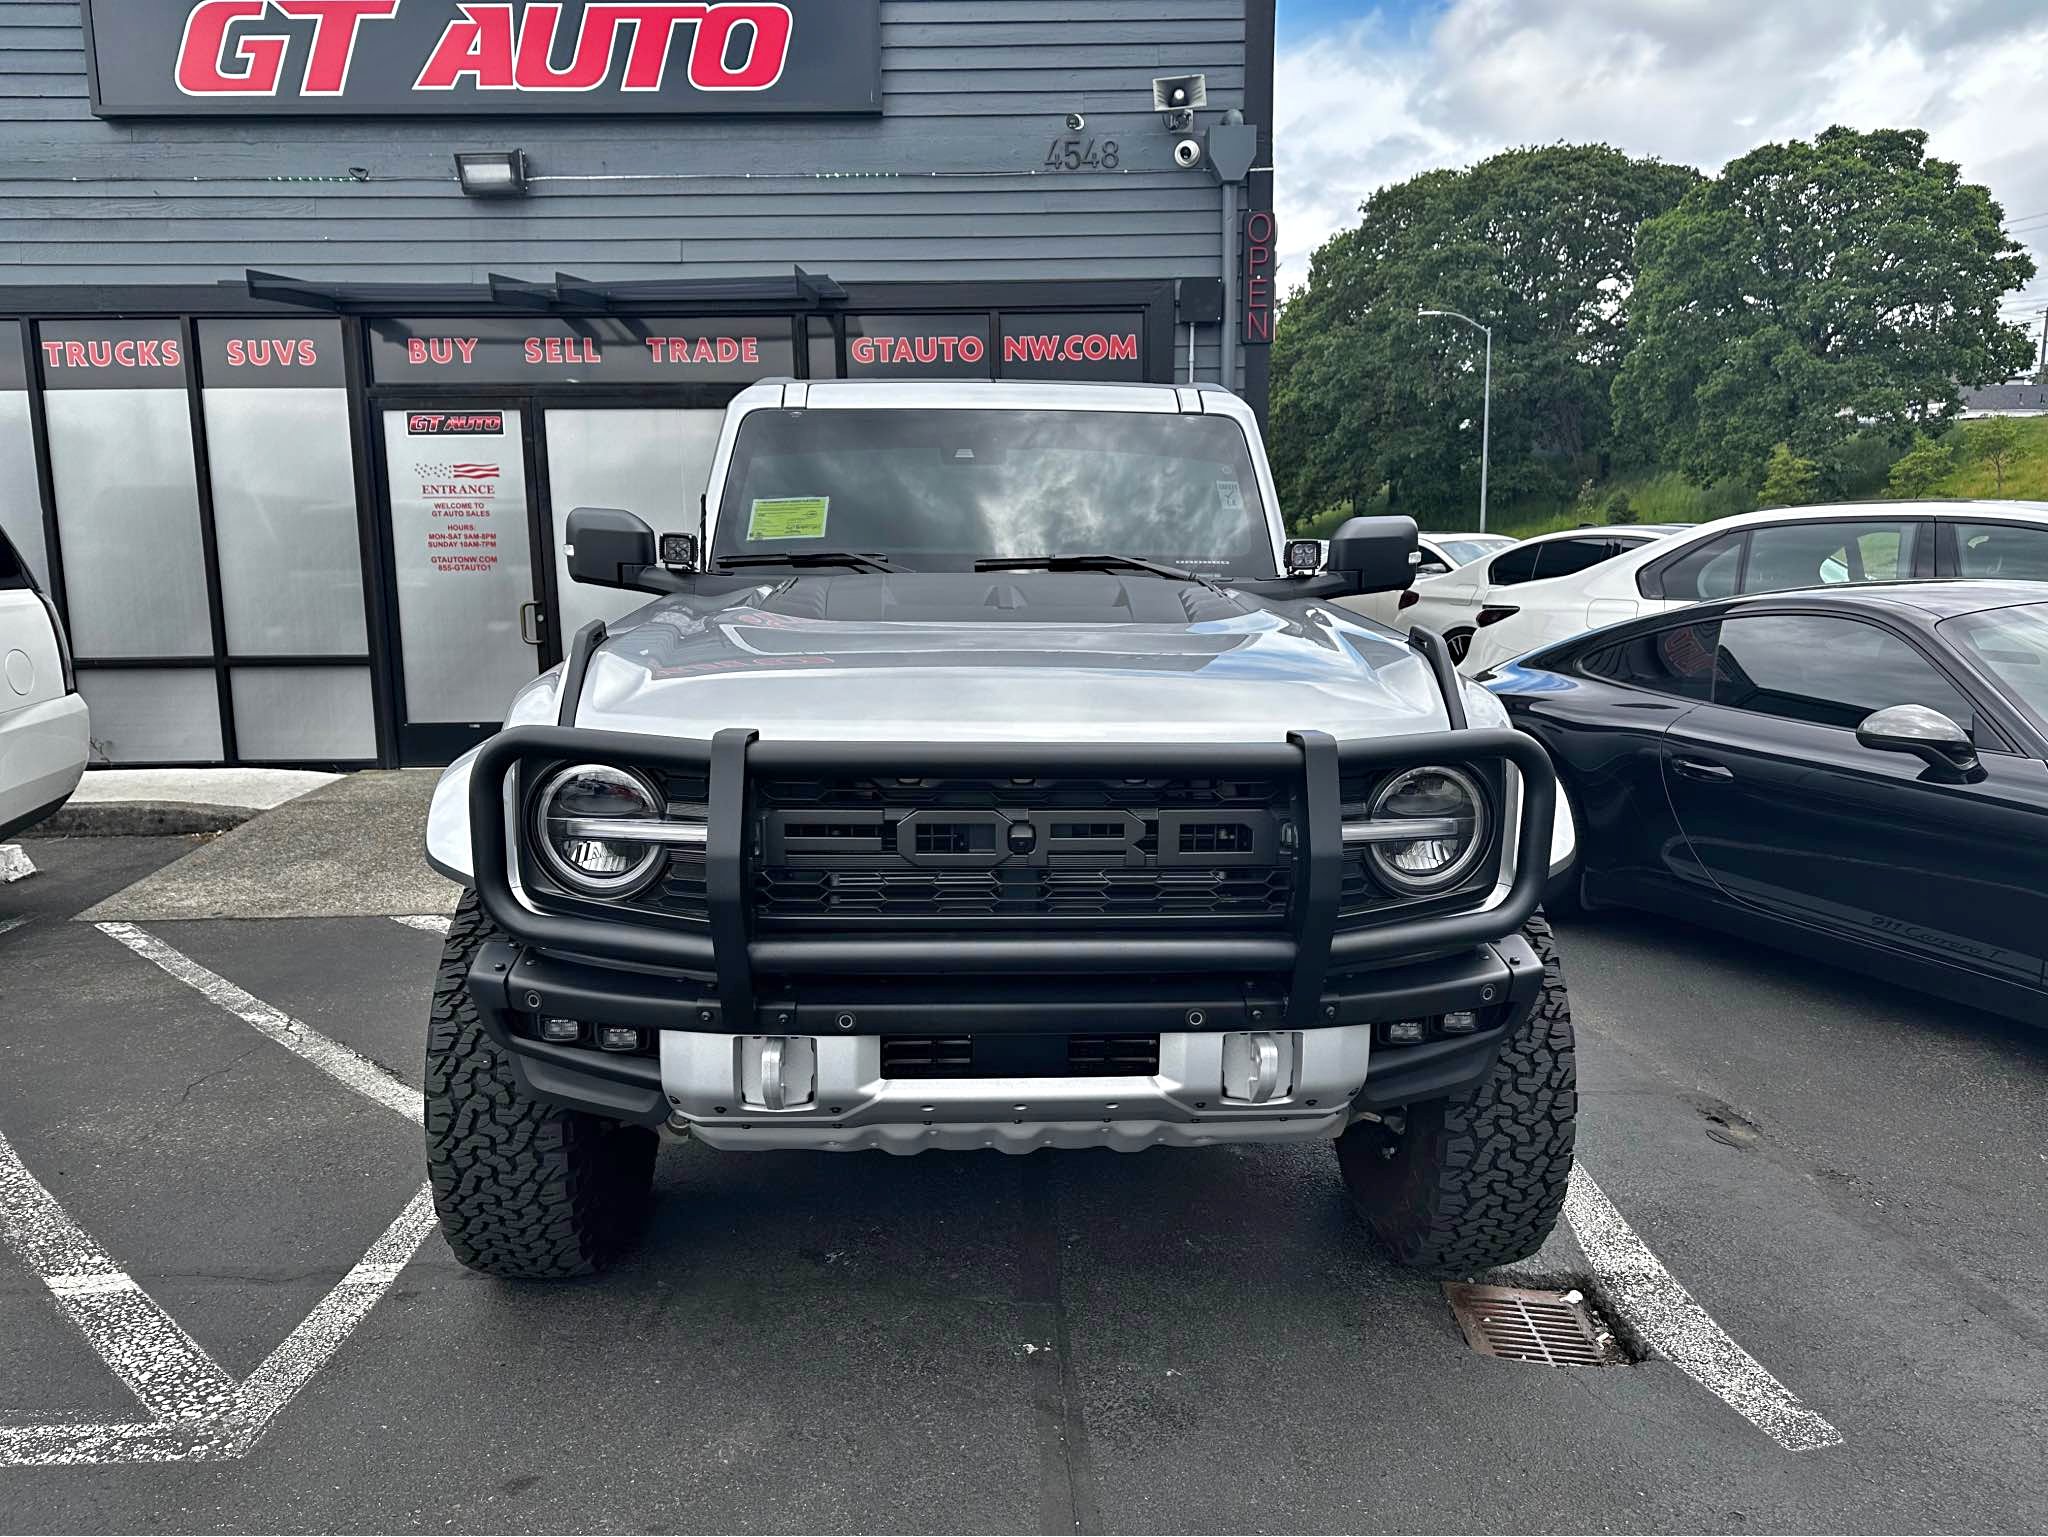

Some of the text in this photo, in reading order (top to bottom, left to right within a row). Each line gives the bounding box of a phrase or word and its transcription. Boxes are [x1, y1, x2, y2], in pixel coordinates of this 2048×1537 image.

[174, 0, 793, 97] GT AUTO
[1045, 137, 1120, 170] 4548
[1247, 213, 1272, 341] OPEN
[43, 339, 181, 369] TRUCKS
[226, 338, 317, 367] SUVS
[407, 335, 760, 365] BUY SELL TRADE
[851, 333, 1138, 364] GTAUTO NW.COM
[409, 415, 502, 432] GT AUTO
[422, 484, 496, 495] ENTRANCE
[760, 808, 1278, 867] FORD
